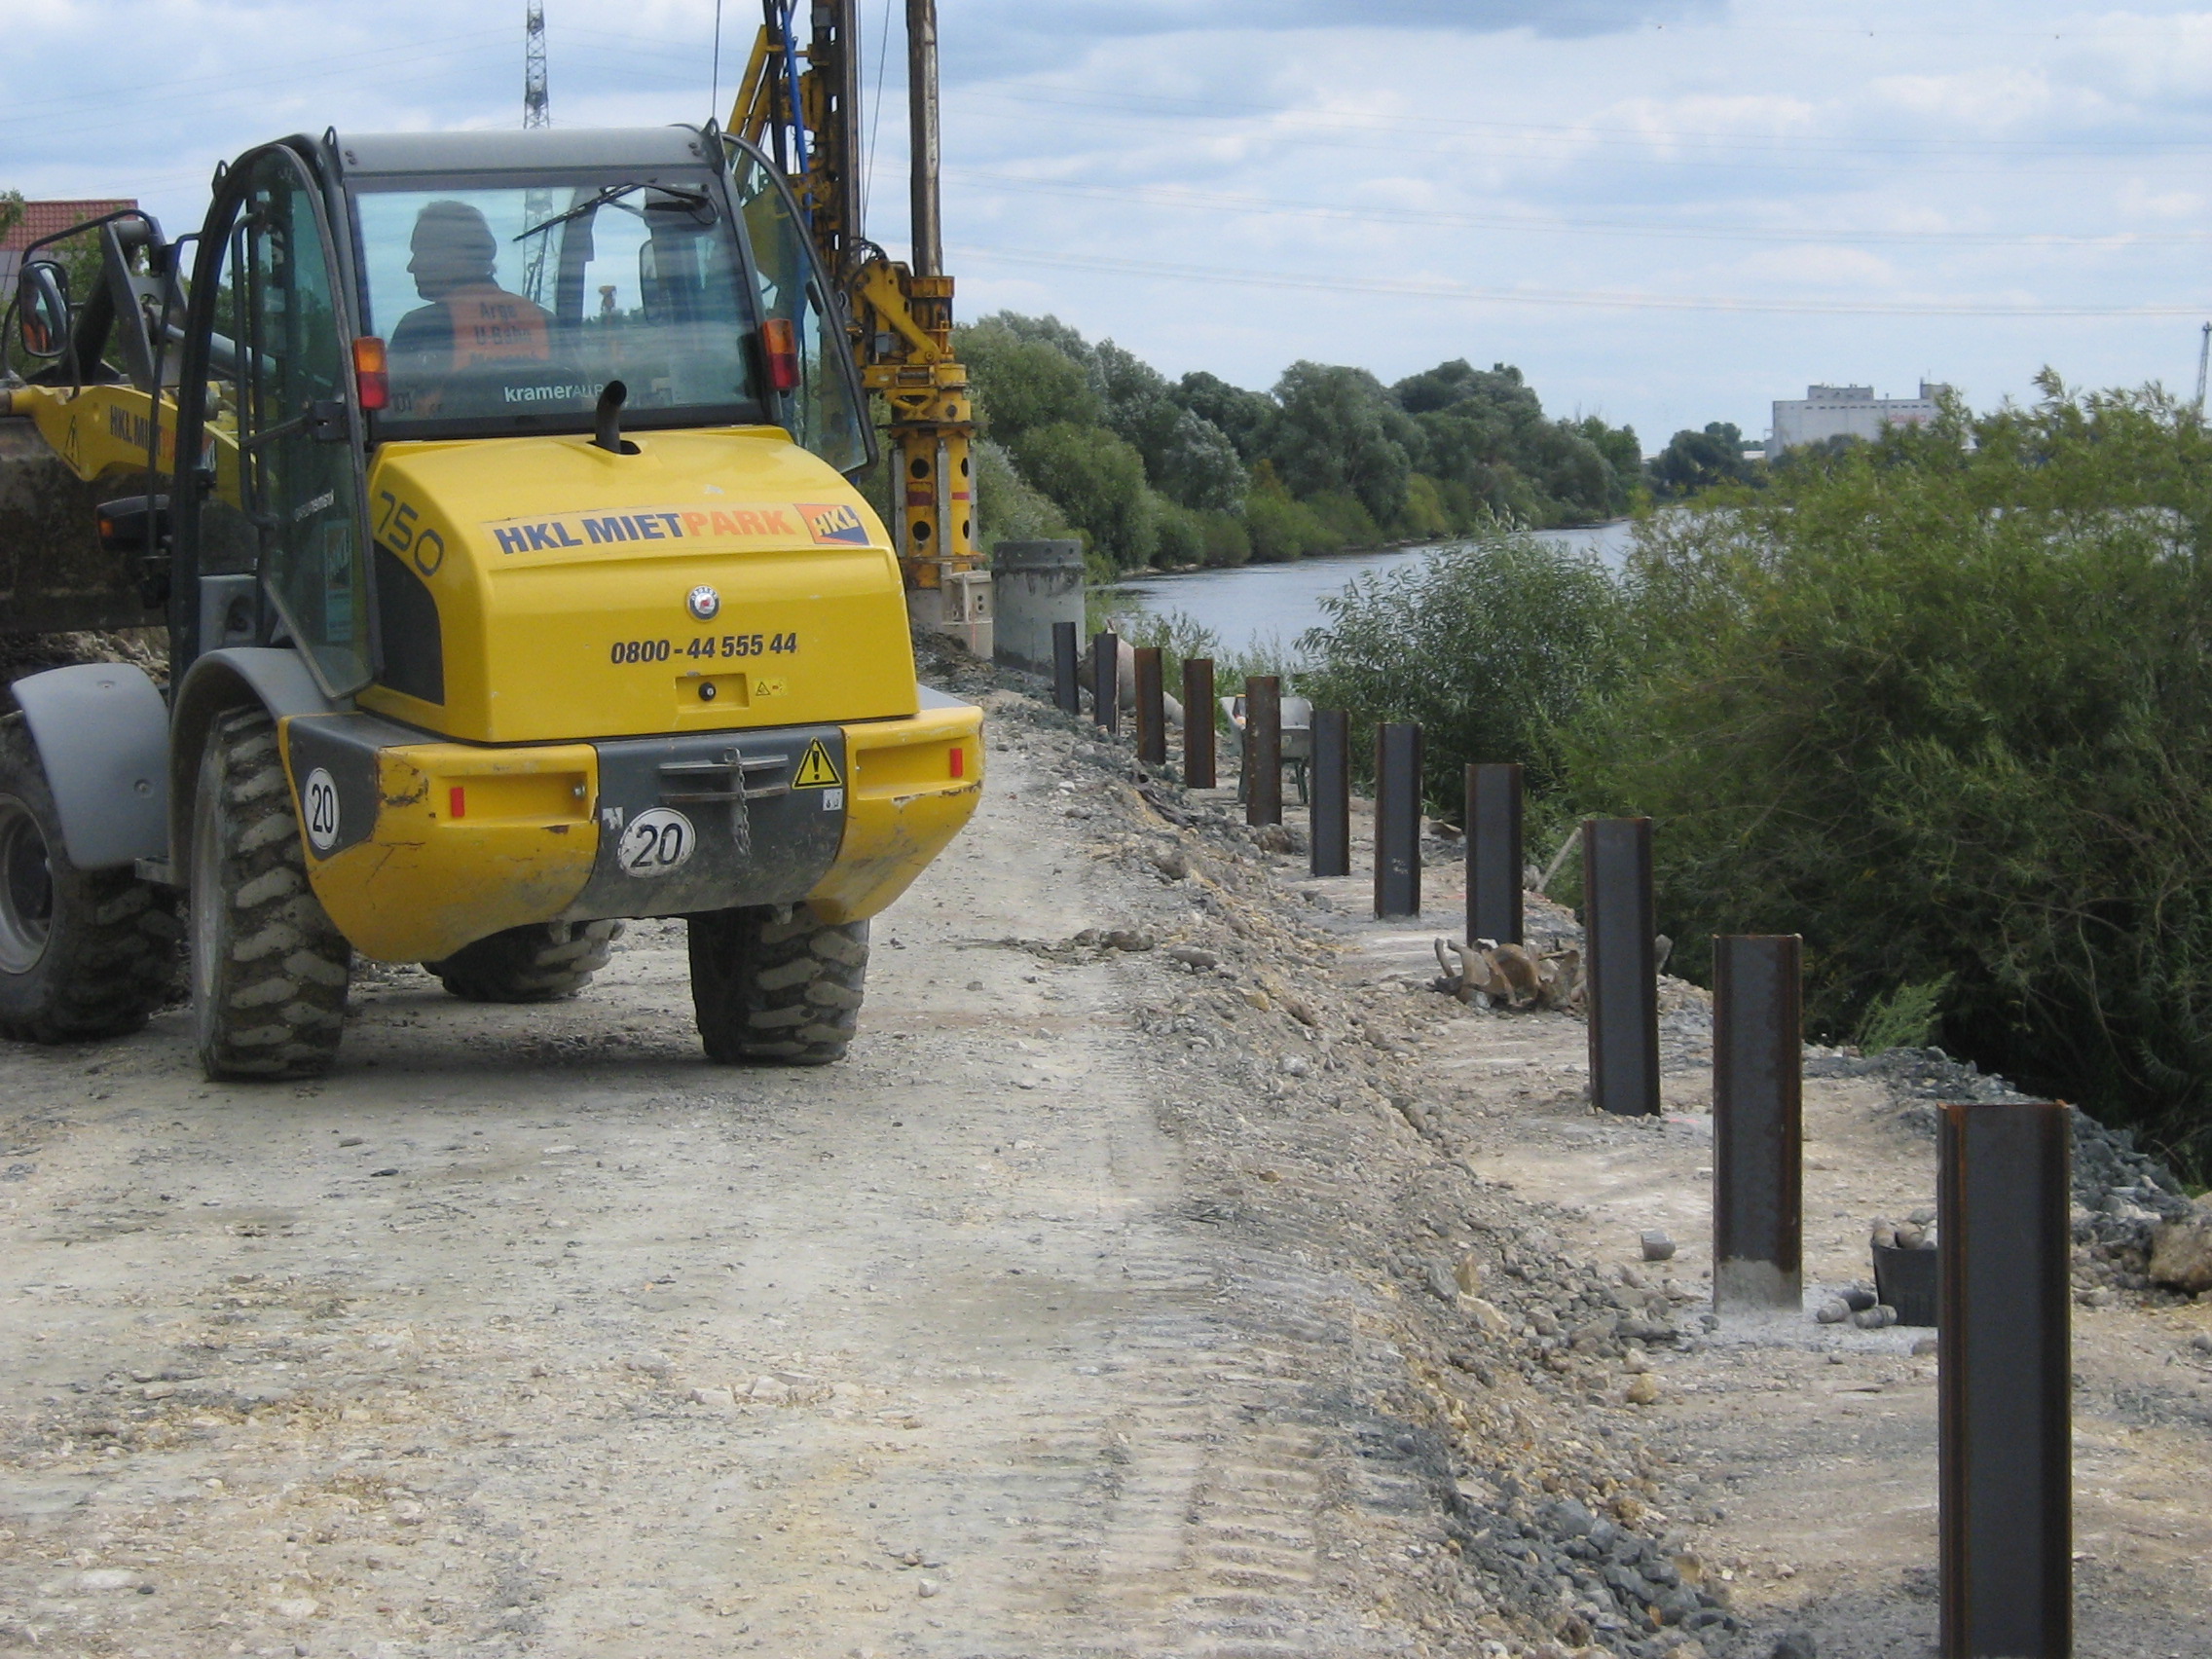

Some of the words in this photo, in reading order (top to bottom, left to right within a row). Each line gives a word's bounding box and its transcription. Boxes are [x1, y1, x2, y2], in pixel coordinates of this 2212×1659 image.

[377, 490, 445, 577] 750
[493, 520, 583, 555] HKL
[812, 505, 859, 537] HKL
[610, 639, 670, 664] 0800
[721, 634, 763, 658] 555
[769, 633, 797, 654] 44
[312, 784, 334, 834] 20
[631, 823, 682, 867] 20
